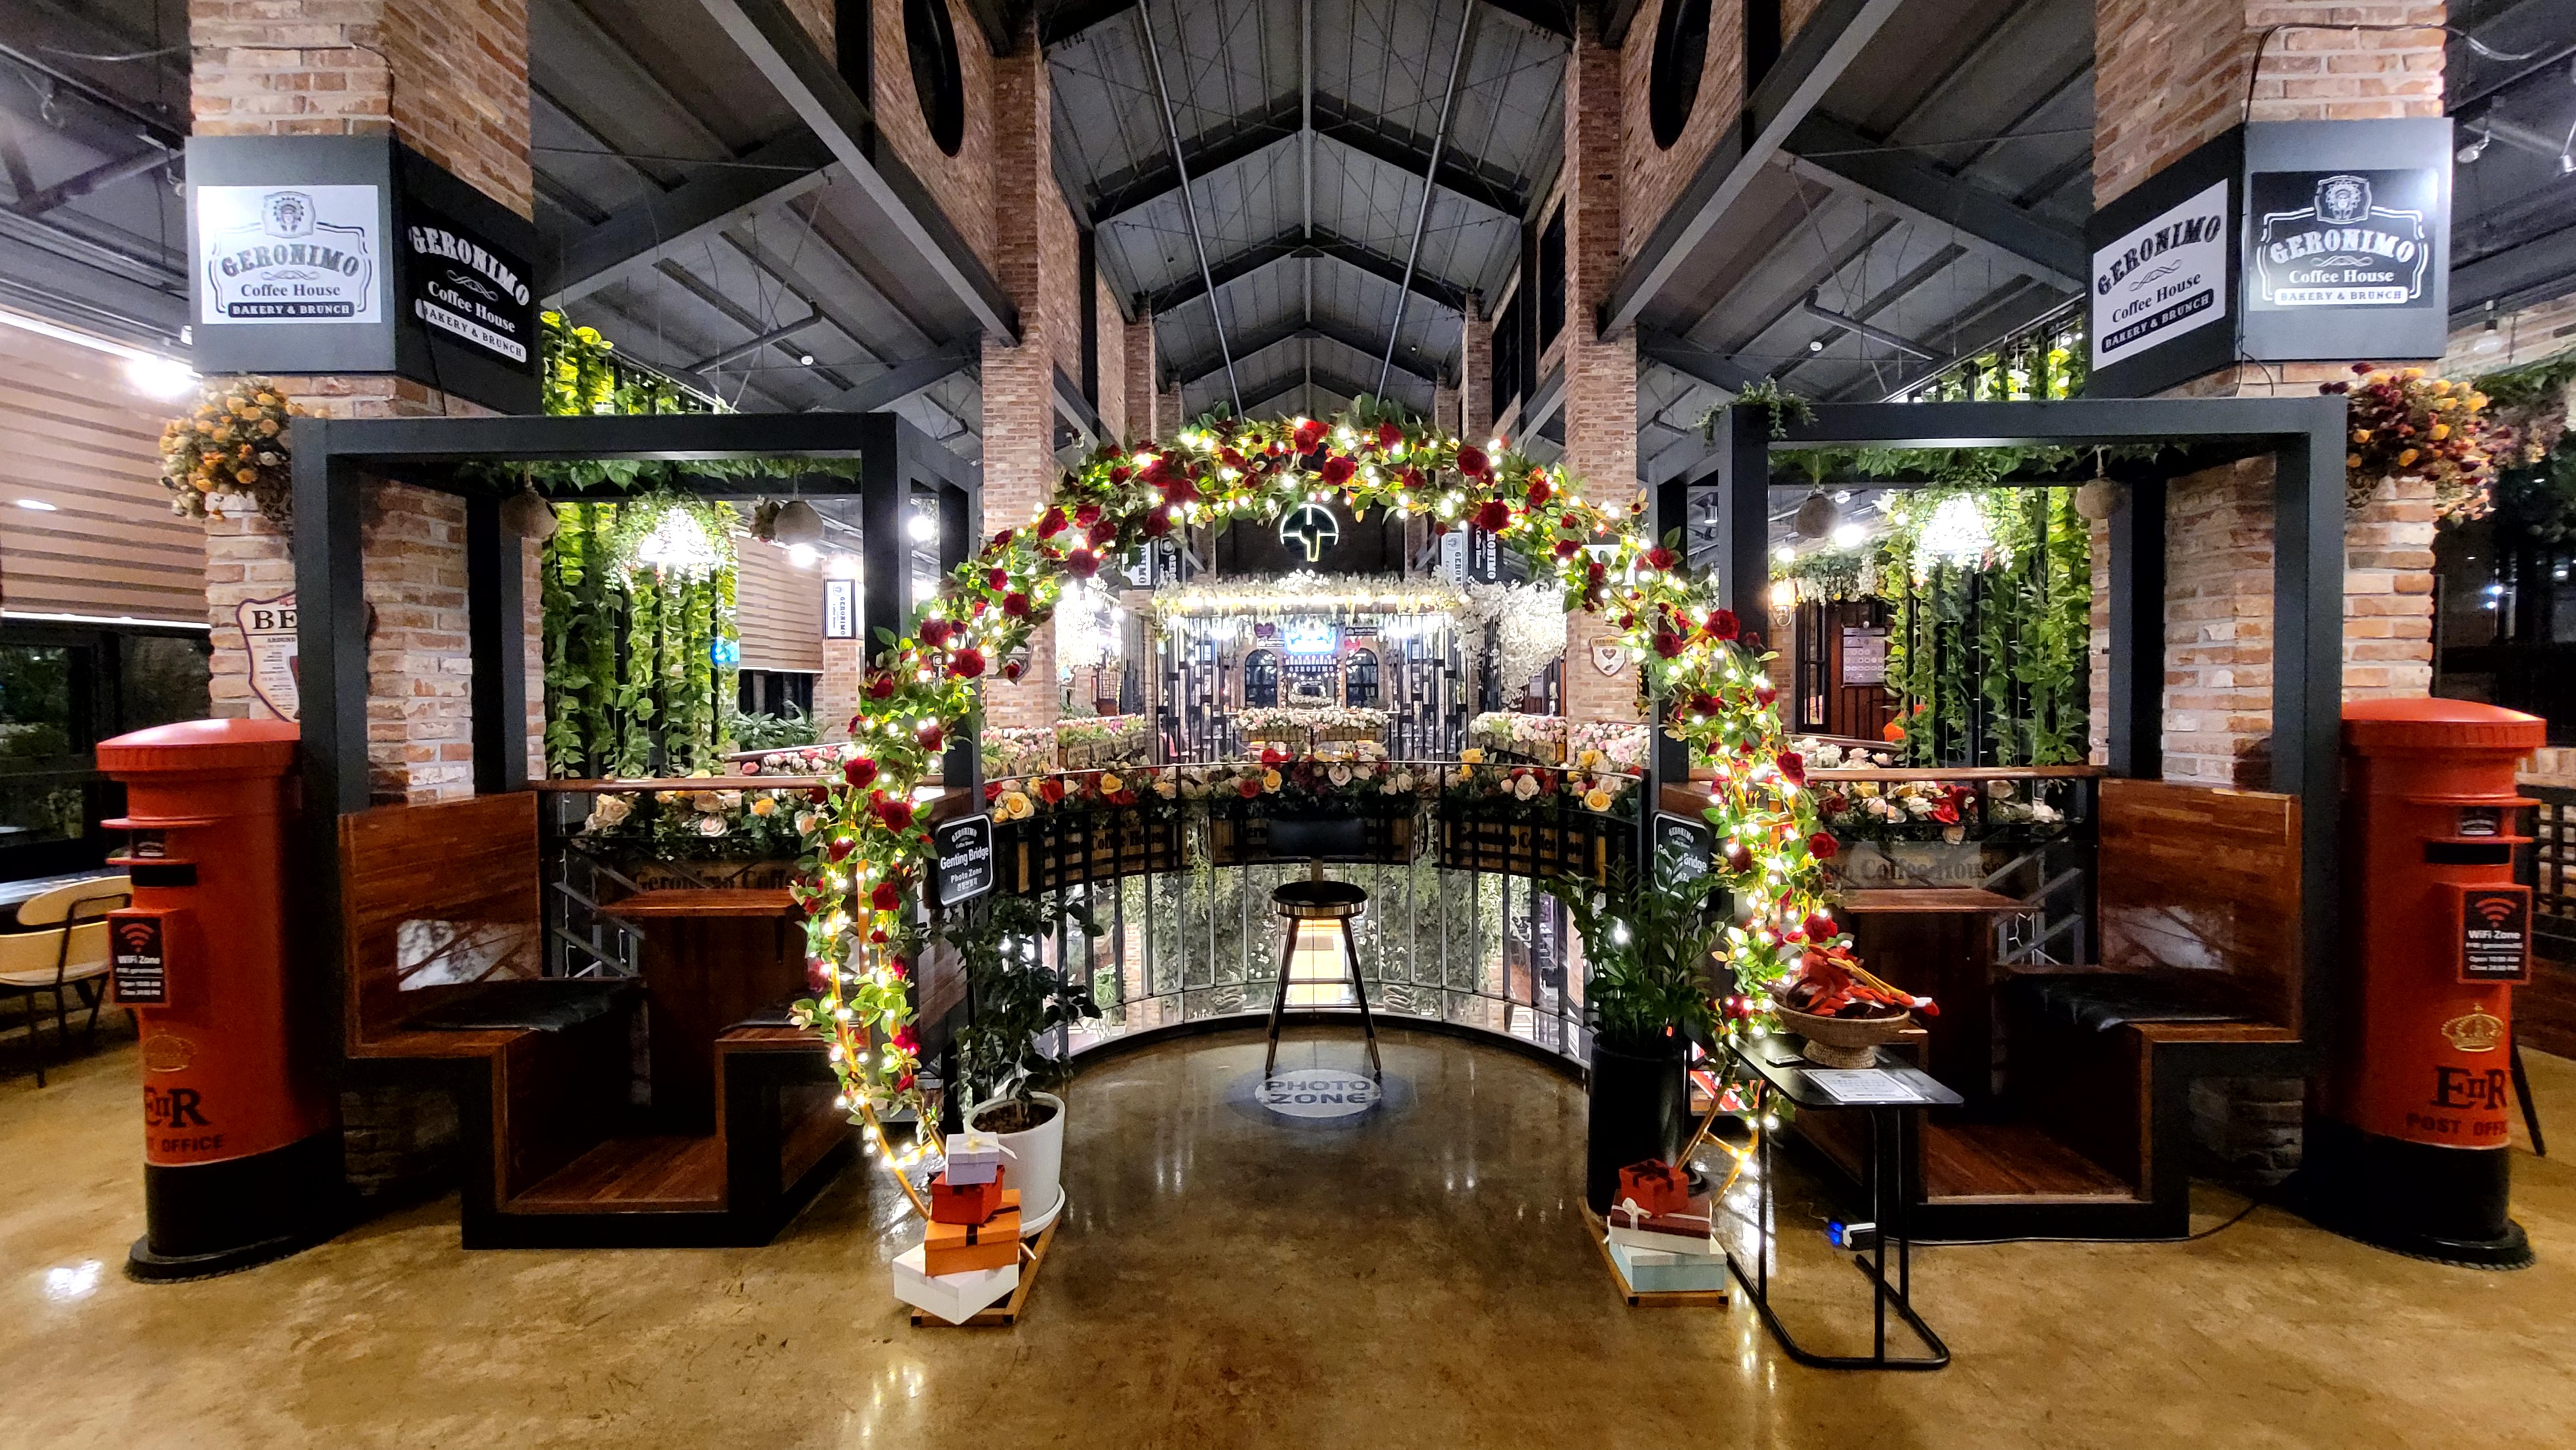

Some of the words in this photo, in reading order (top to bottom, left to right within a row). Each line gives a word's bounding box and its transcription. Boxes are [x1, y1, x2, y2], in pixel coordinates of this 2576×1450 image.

[2098, 214, 2221, 296] GERONIMO
[2270, 229, 2416, 264] GERONIMO
[222, 243, 359, 278] GERONIMO
[408, 226, 530, 306] GERONIMO
[2288, 269, 2340, 284] Coffee
[2343, 269, 2395, 284] House
[240, 283, 288, 297] Coffee
[293, 283, 341, 297] House
[2112, 296, 2152, 323] Coffee
[2156, 271, 2202, 302] House
[2280, 290, 2334, 301] BAKERY
[2336, 291, 2347, 301] &
[2350, 290, 2402, 301] BRUNCH
[231, 304, 283, 315] BAKERY
[287, 305, 296, 315] &
[299, 305, 350, 315] BRUNCH
[428, 281, 473, 312] Coffee
[475, 302, 516, 333] House
[2105, 323, 2148, 350] BAKERY
[2150, 317, 2158, 329] &
[2162, 296, 2211, 325] BRUNCH
[471, 328, 478, 337] &
[482, 332, 522, 357] BRUNCH
[952, 827, 978, 843] GERONIMO
[940, 852, 968, 870] Genting
[969, 846, 989, 862] Bridge
[1683, 852, 1707, 873] Bridge
[951, 871, 968, 883] Photo
[969, 867, 982, 877] Zone
[2468, 930, 2492, 939] WiFi
[2493, 930, 2521, 939] Zone
[117, 955, 137, 964] WiFi
[138, 956, 160, 965] Zone
[1264, 1080, 1371, 1091] PHOTO
[1269, 1093, 1367, 1104] ZONE
[2406, 1113, 2462, 1135] POST
[162, 1134, 225, 1153] OFFICE
